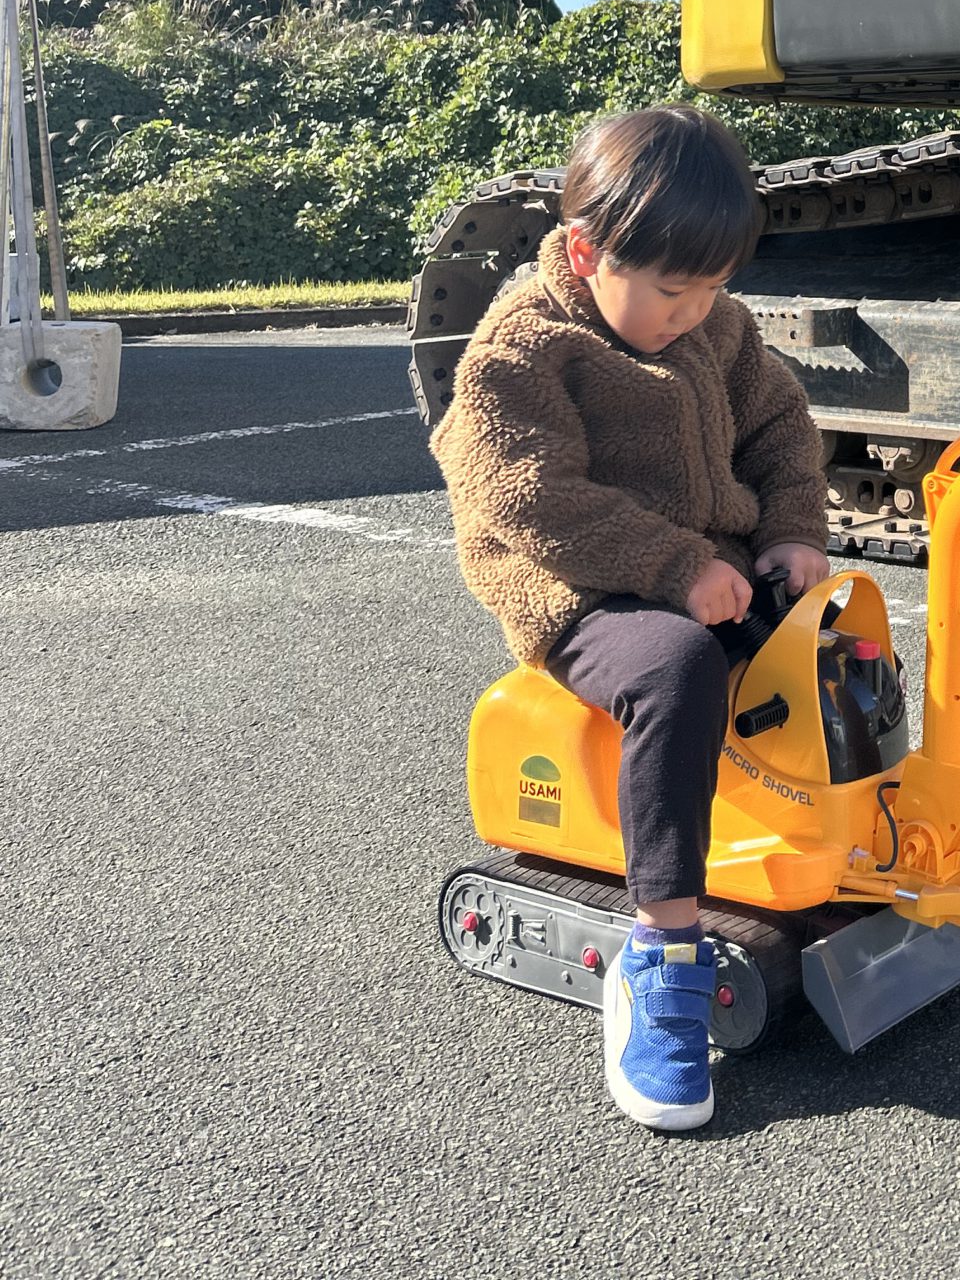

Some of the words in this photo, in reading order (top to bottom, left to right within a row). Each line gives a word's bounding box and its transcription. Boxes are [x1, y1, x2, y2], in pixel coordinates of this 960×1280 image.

[519, 779, 561, 801] USAMI
[720, 740, 760, 780] MICRO
[762, 775, 815, 807] SHOVEL
